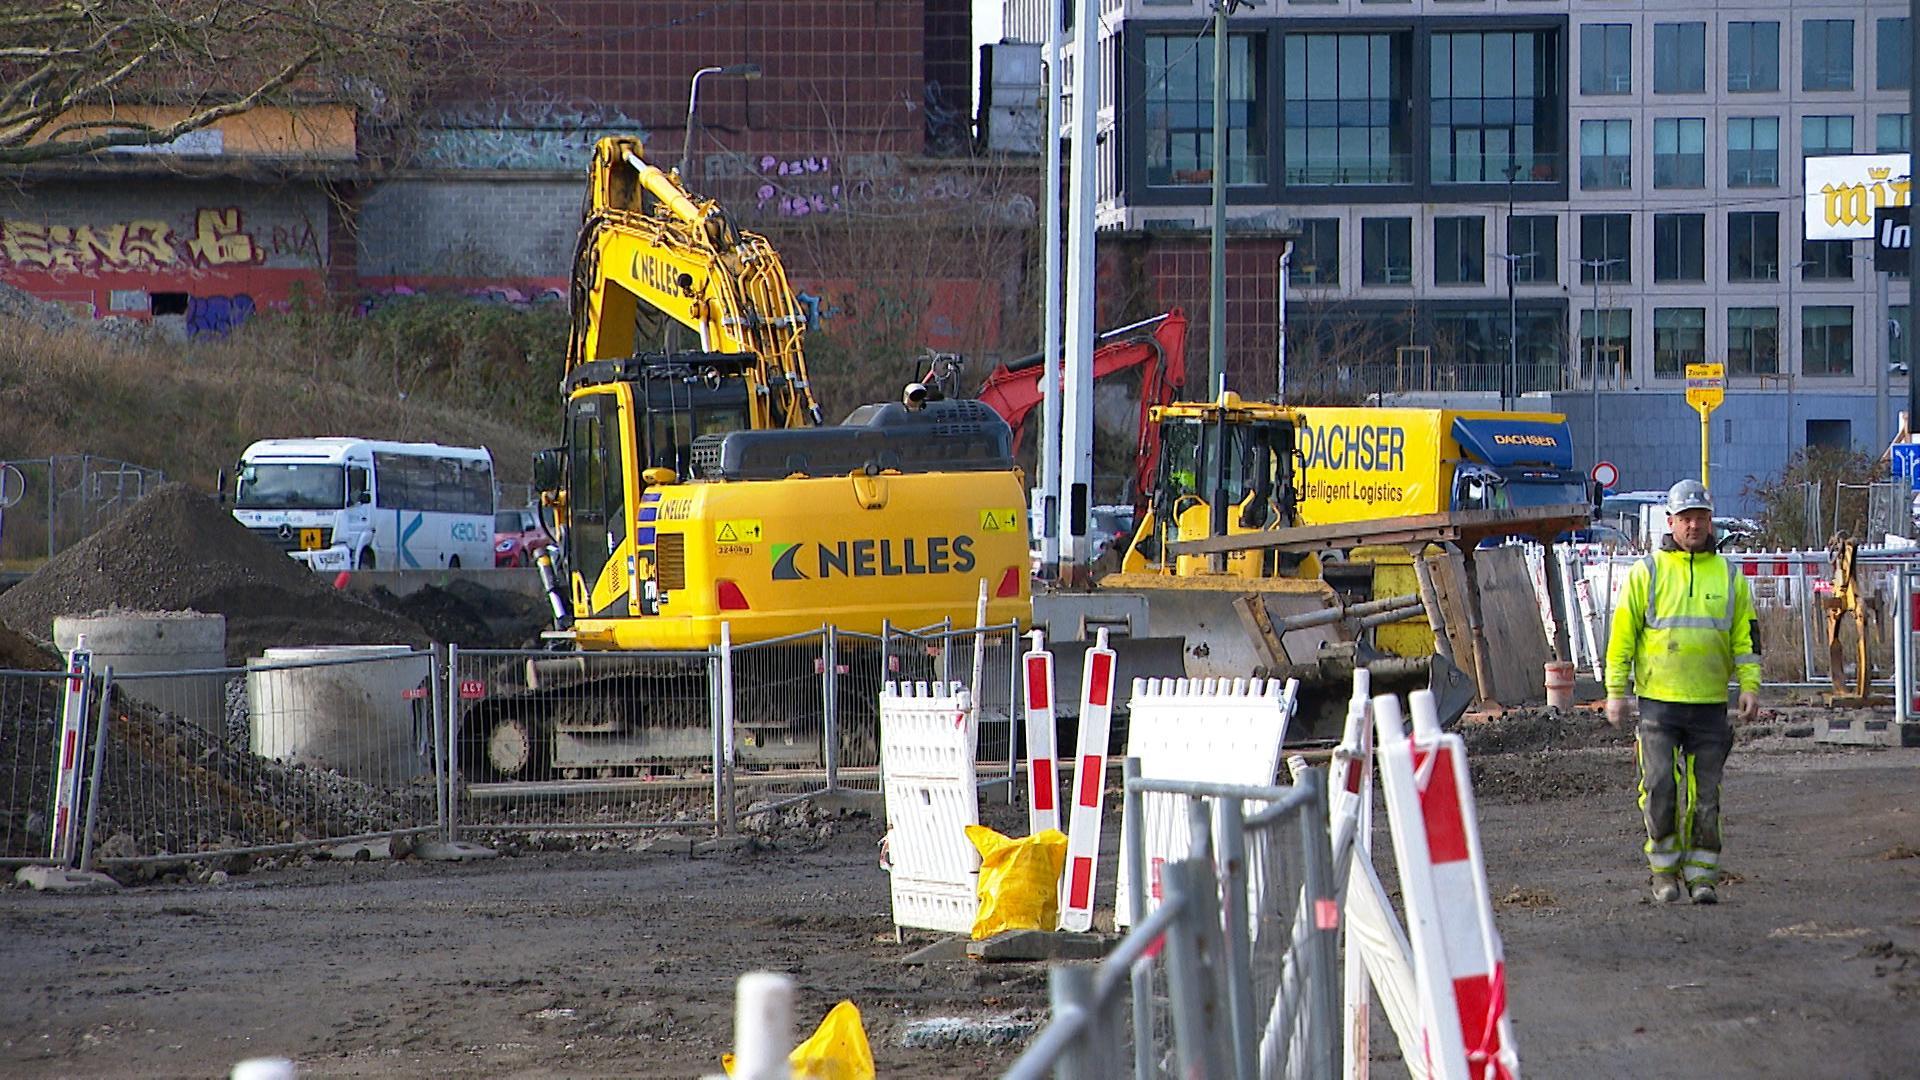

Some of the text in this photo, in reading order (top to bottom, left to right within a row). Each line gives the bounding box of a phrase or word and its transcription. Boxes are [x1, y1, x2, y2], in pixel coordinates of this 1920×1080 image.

[641, 252, 679, 298] NELLES
[1298, 424, 1404, 472] DACHSER
[1494, 434, 1558, 448] DACHSER
[663, 499, 692, 520] NELLES
[1353, 480, 1403, 505] Logistics
[818, 536, 975, 579] NELLES
